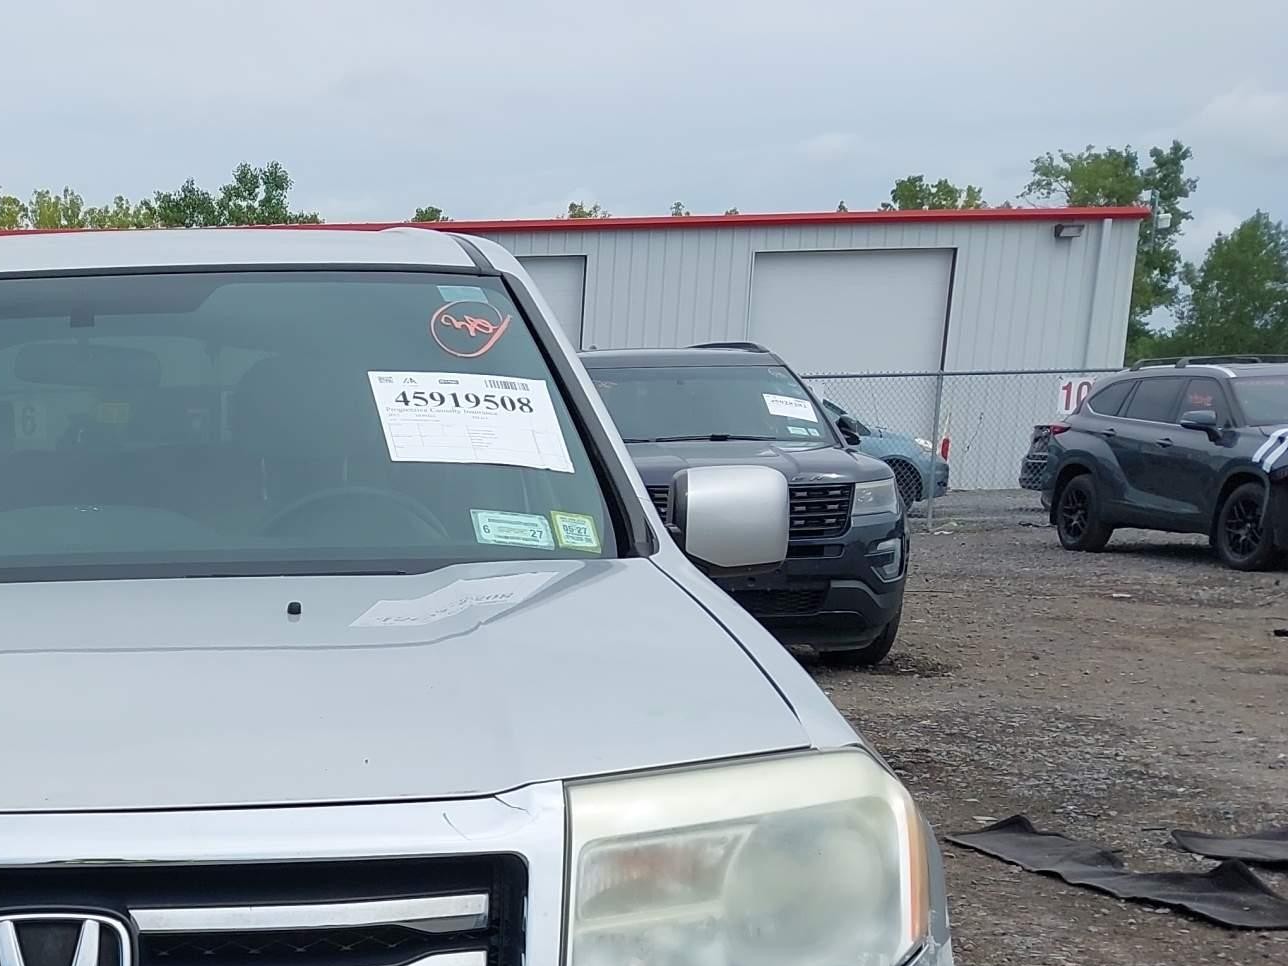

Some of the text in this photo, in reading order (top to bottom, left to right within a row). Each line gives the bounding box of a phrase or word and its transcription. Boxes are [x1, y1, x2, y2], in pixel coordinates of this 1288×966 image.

[395, 390, 534, 414] 45919508
[482, 524, 491, 534] 6
[530, 529, 543, 539] 27
